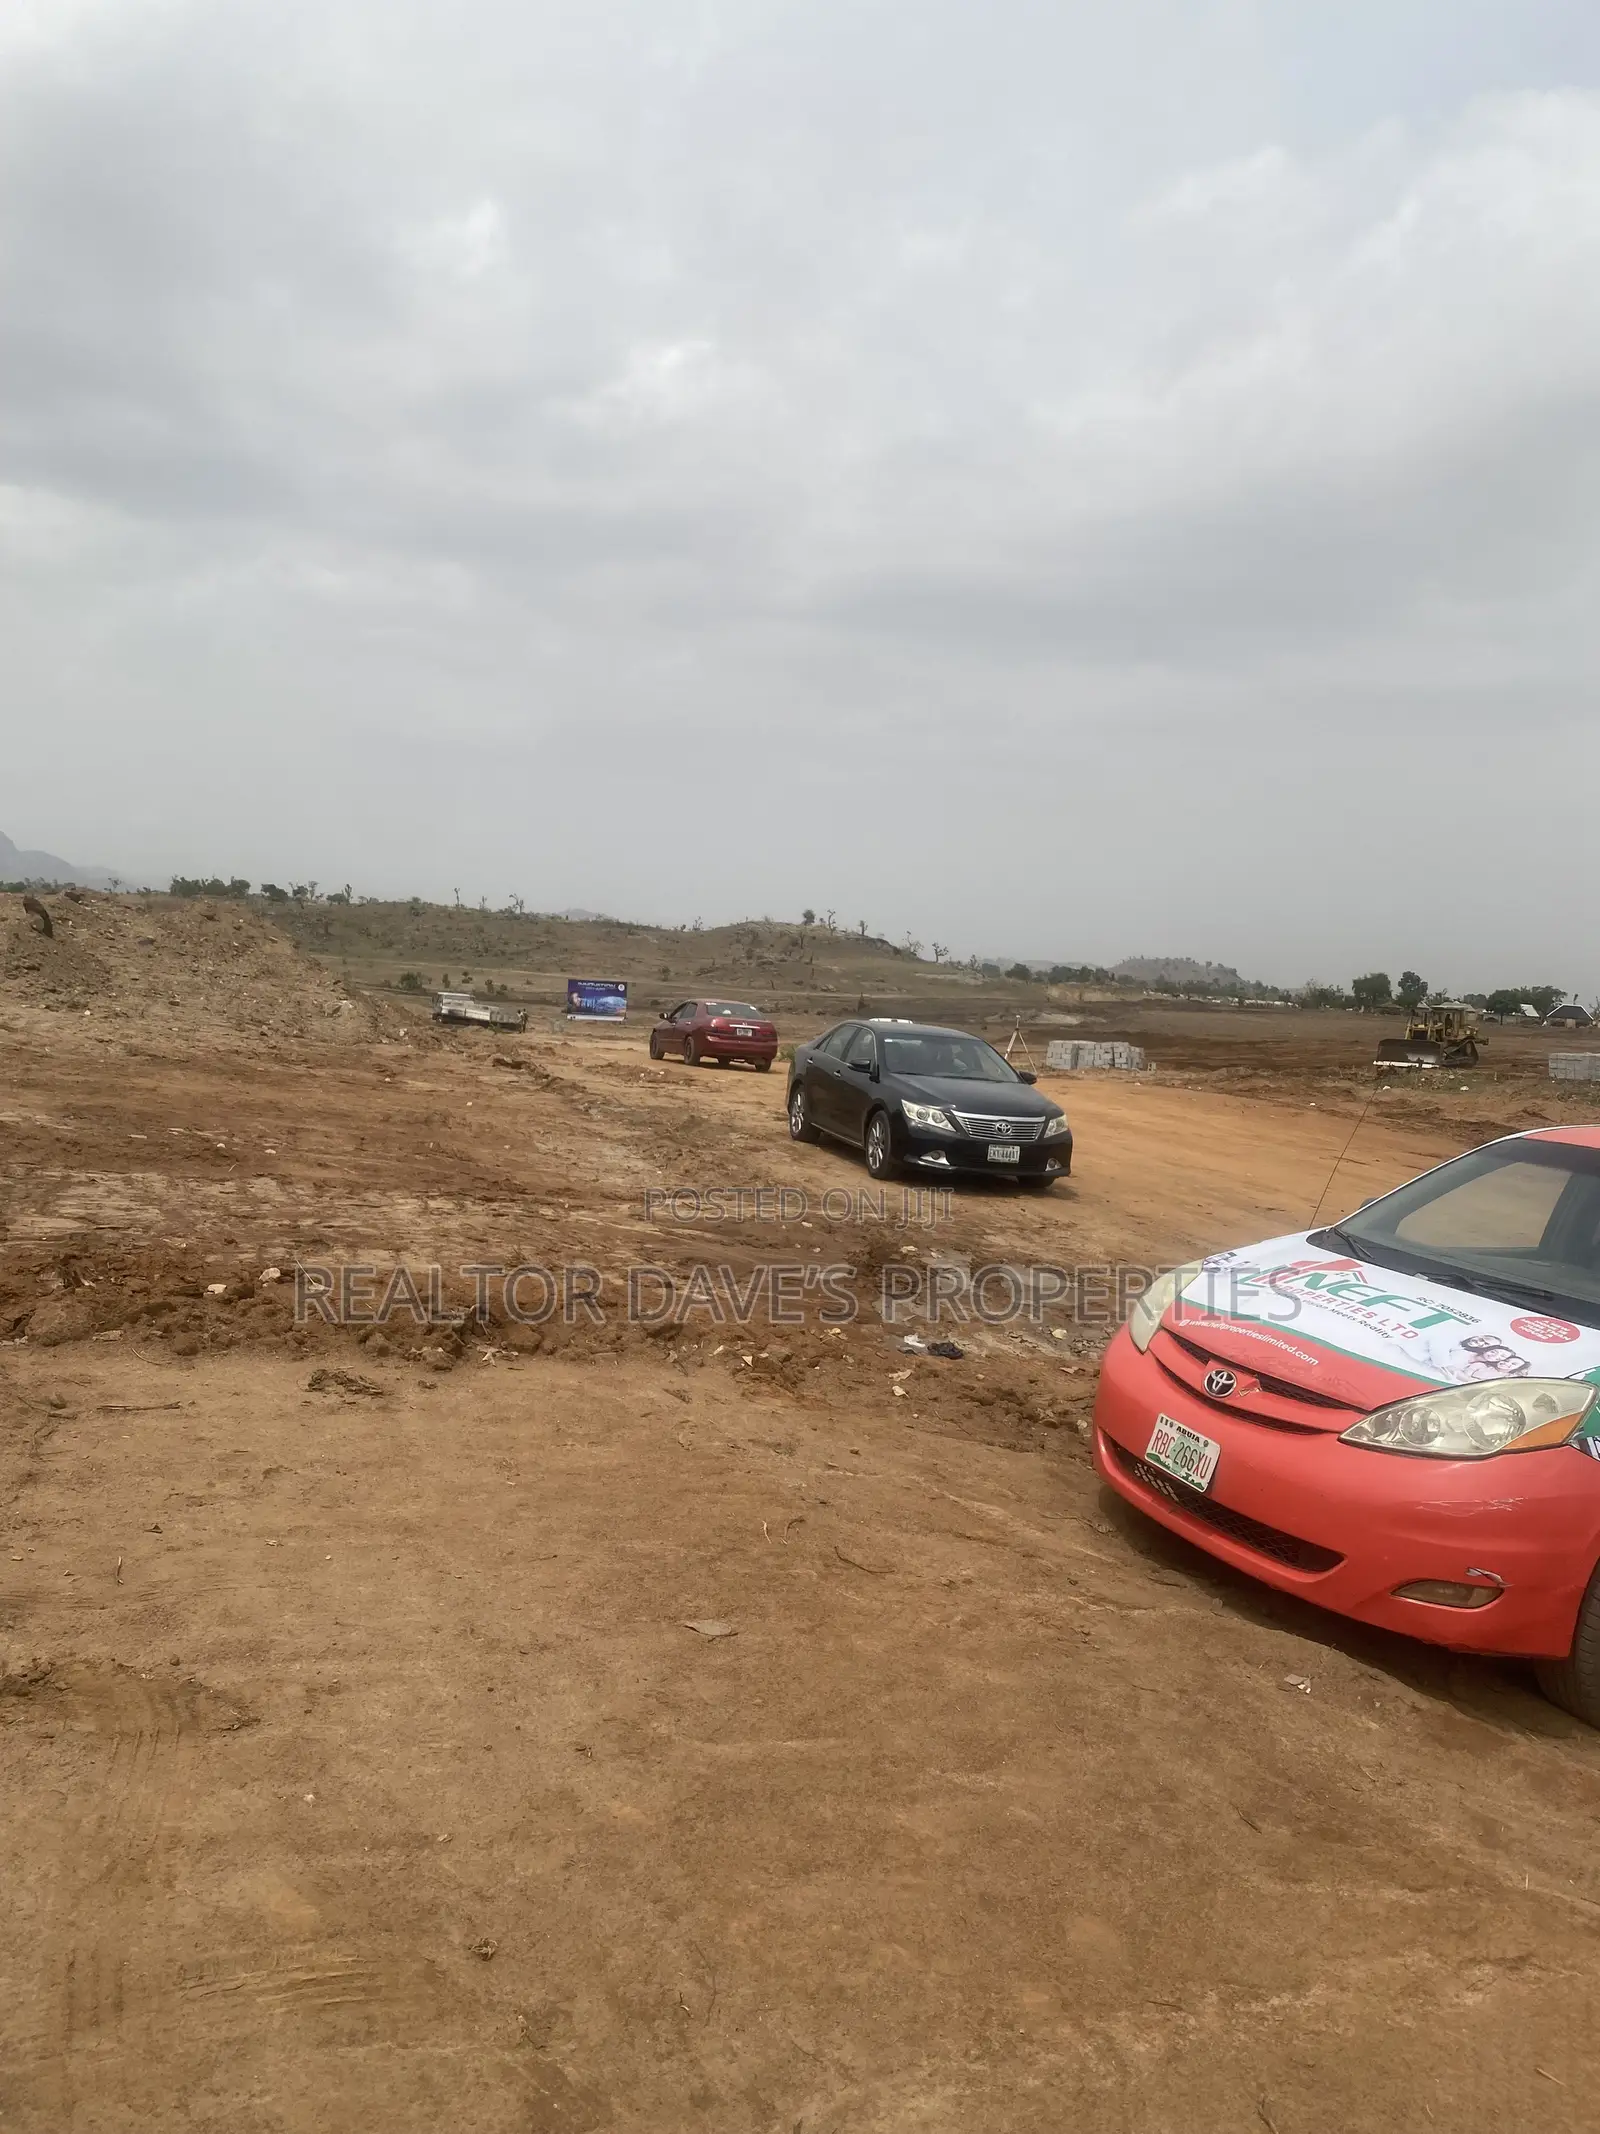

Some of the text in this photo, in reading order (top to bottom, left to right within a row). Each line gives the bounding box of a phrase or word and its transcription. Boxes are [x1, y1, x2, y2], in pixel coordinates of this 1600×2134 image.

[1284, 1271, 1472, 1329] NEFT
[1357, 1319, 1394, 1340] Reality
[1378, 1317, 1420, 1340] LTD
[1176, 1425, 1201, 1444] ABUJA
